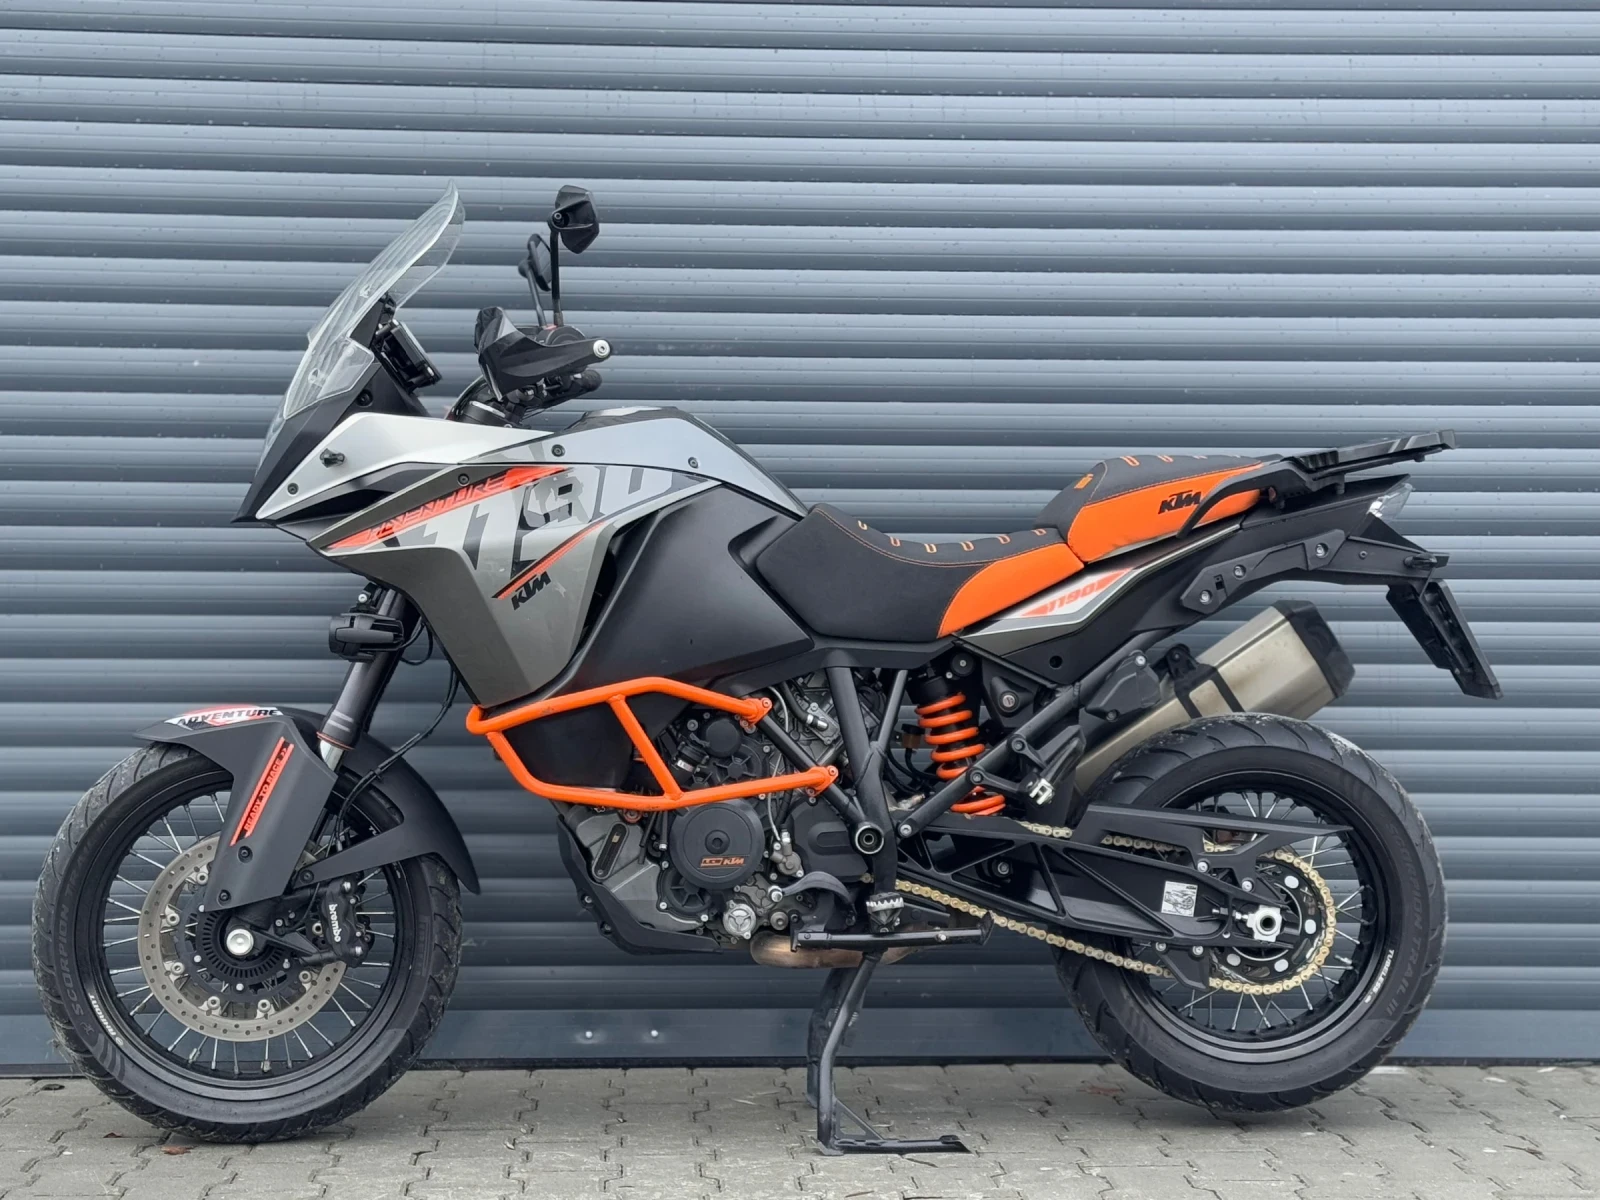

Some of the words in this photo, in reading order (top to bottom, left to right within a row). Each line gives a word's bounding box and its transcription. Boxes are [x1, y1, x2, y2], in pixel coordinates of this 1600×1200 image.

[1158, 490, 1201, 514] KTM
[511, 571, 552, 611] KTM
[1047, 582, 1098, 611] 1190
[177, 708, 279, 727] ADVENTURE
[244, 797, 263, 830] READY
[267, 758, 283, 784] RACE
[723, 857, 745, 865] KTM
[328, 903, 342, 943] brembo
[59, 904, 85, 1016] SCORPION
[1396, 938, 1421, 995] TRAIL
